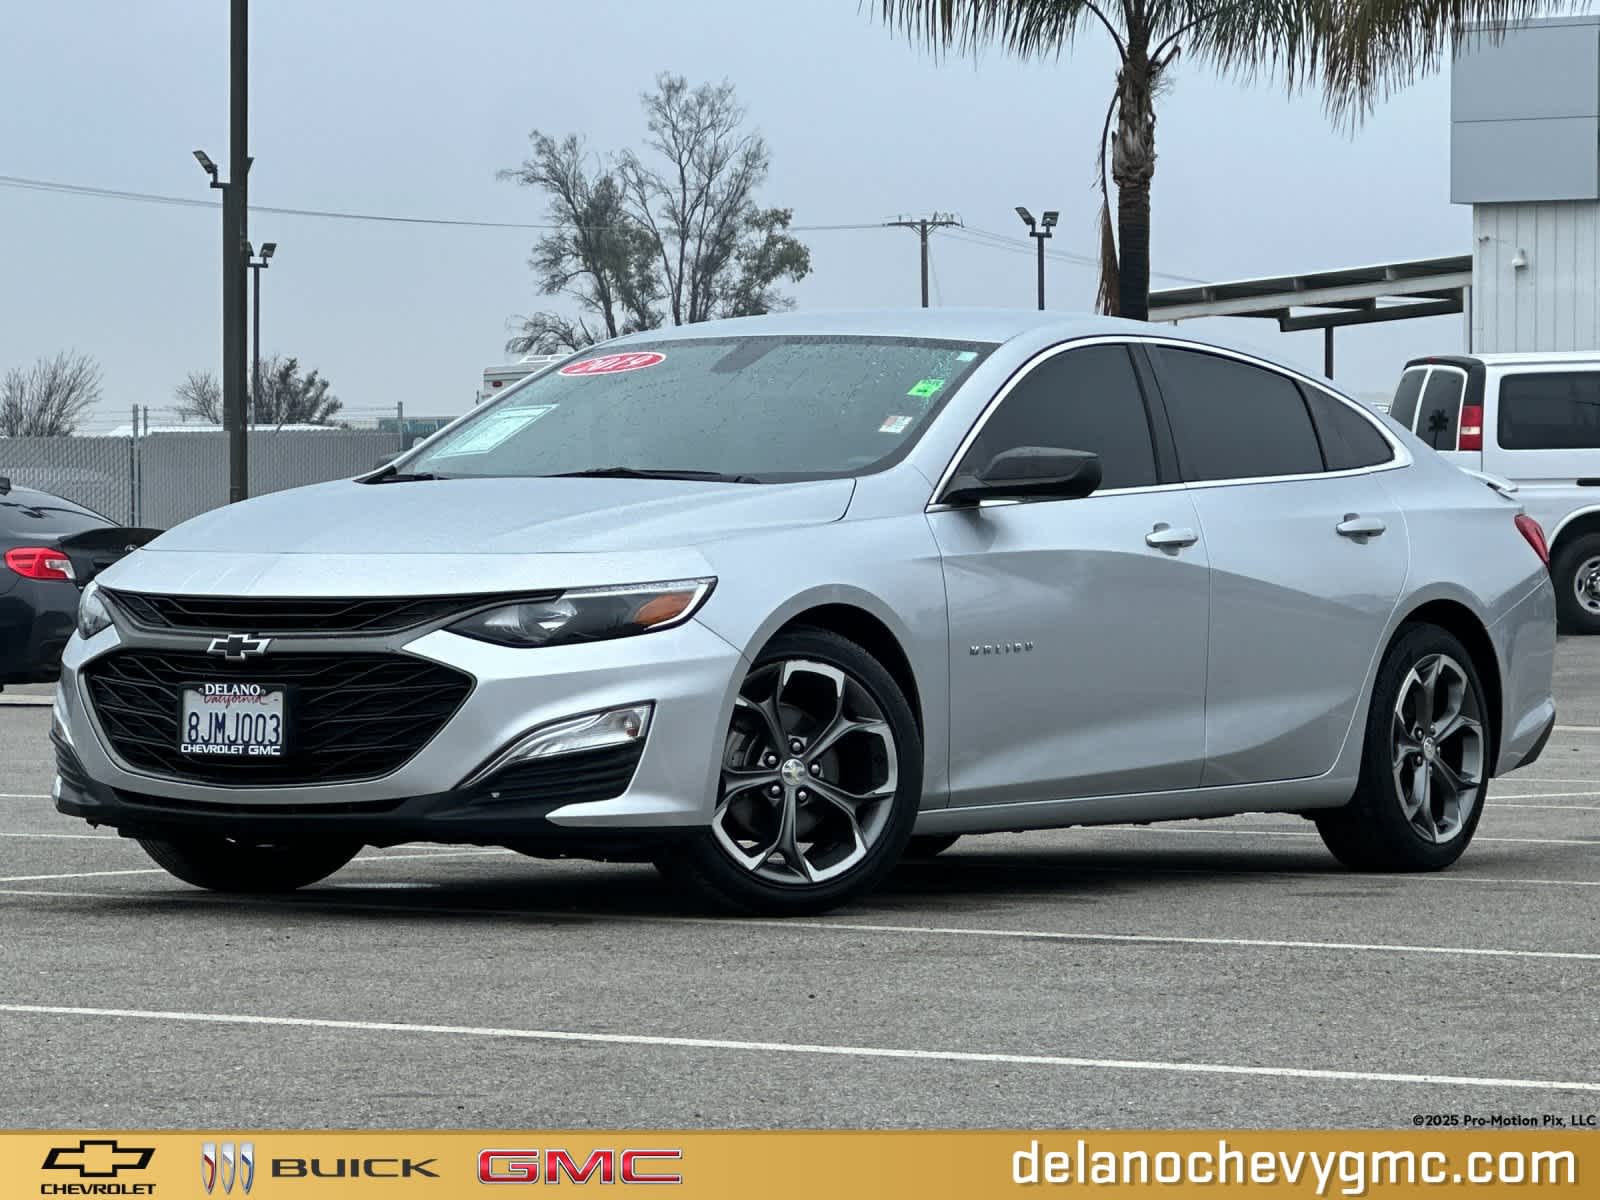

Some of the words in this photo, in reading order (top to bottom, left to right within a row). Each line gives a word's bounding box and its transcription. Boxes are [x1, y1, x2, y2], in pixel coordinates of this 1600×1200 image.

[204, 684, 261, 696] DELANO
[188, 712, 280, 744] 8JMJ003
[181, 743, 244, 754] CHEVROLET
[248, 745, 281, 756] GMC
